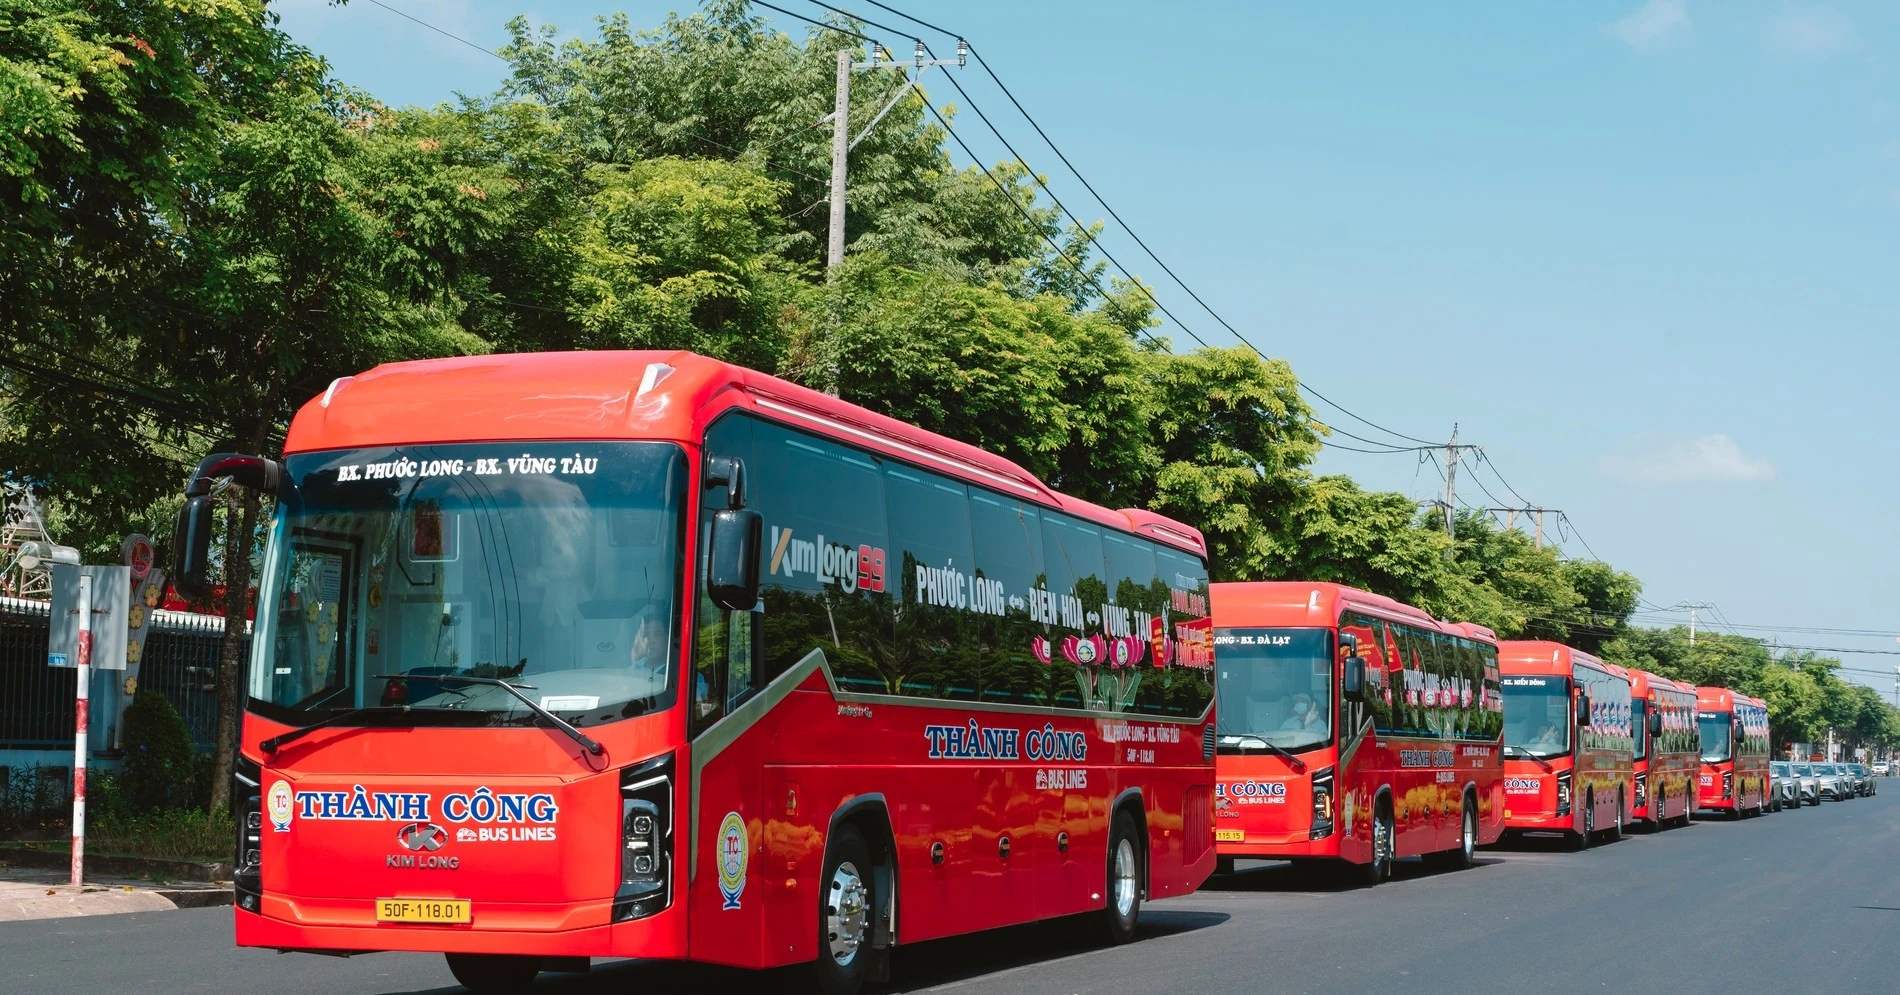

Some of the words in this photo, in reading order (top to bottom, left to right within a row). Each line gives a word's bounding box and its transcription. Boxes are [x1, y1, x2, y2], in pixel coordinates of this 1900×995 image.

[337, 465, 361, 482] BX.
[365, 456, 417, 480] PHƯỚC
[419, 459, 464, 476] LONG
[475, 458, 502, 475] BX.
[507, 453, 557, 474] VŨNG
[560, 453, 599, 474] TÀU
[916, 558, 966, 610] PHƯỚC
[969, 575, 1006, 617] LONG
[1028, 582, 1058, 625] BIÊN
[1061, 586, 1085, 630] HÒA
[1101, 598, 1132, 637] VŨNG
[1134, 602, 1152, 643] TÀU
[1241, 636, 1255, 644] BX.
[1257, 633, 1271, 645] ĐÀ
[1272, 636, 1291, 646] LẠT
[924, 718, 1020, 760] THÀNH
[1025, 722, 1088, 761] CÔNG
[1400, 745, 1431, 768] THÀNH
[1432, 746, 1455, 768] CÔNG
[1048, 769, 1064, 790] BUS
[1065, 769, 1087, 790] LINES
[1231, 779, 1287, 796] CÔNG
[295, 784, 431, 822] THÀNH
[441, 785, 559, 824] CÔNG
[478, 827, 510, 841] BUS
[511, 827, 557, 841] LINES
[1215, 832, 1241, 840] -115.15
[385, 855, 415, 868] KIM
[418, 856, 460, 870] LONG
[384, 903, 462, 919] 50F-118.01
